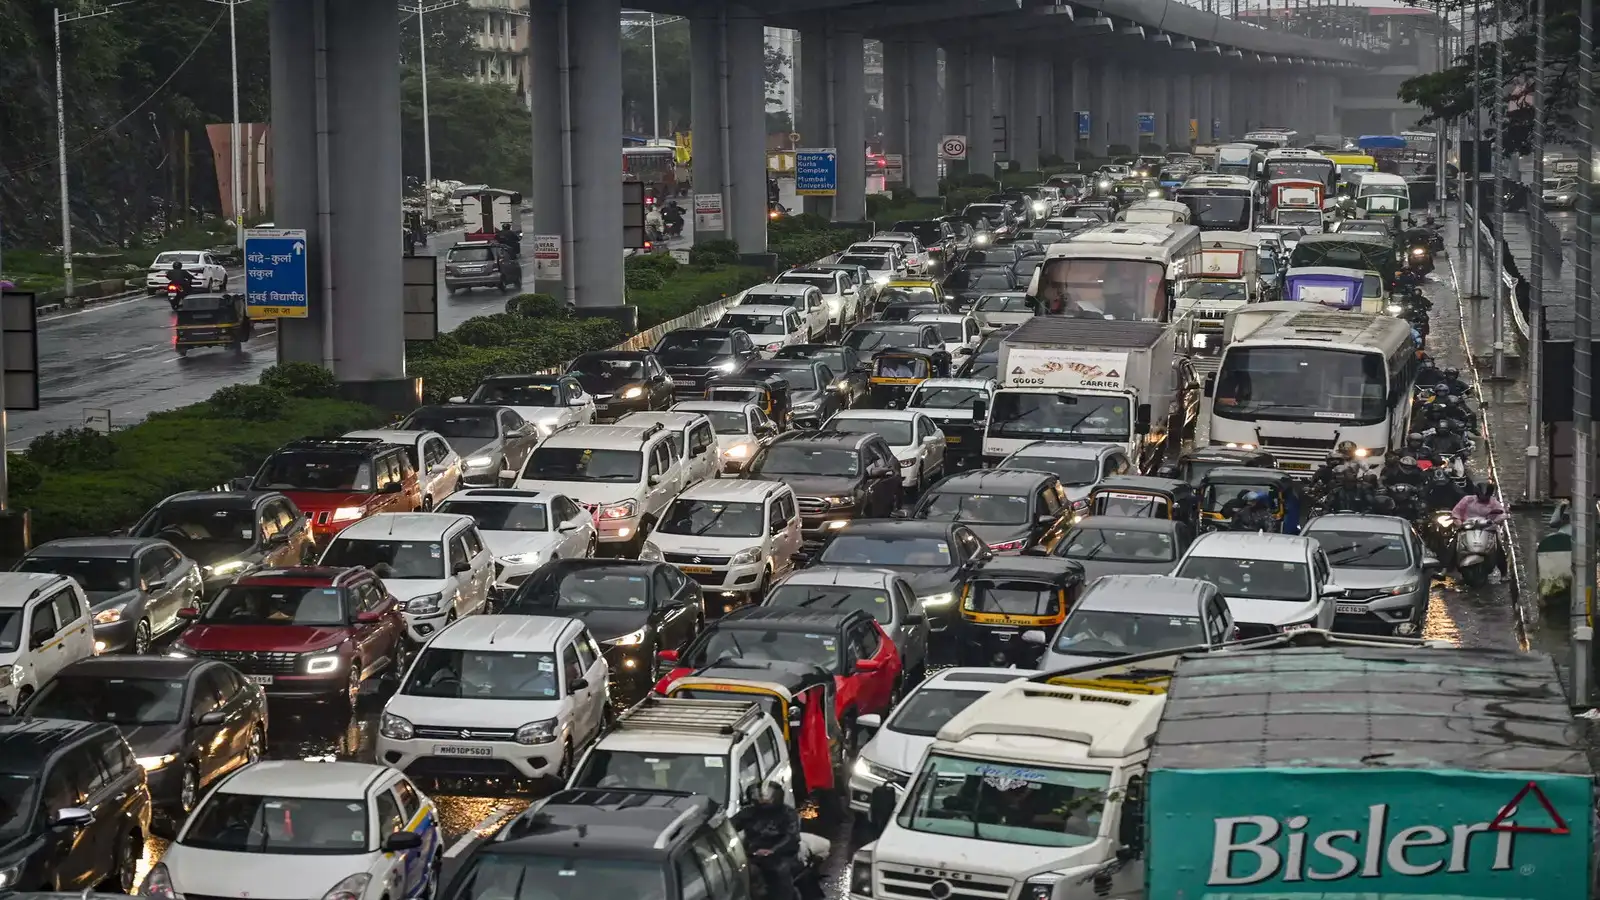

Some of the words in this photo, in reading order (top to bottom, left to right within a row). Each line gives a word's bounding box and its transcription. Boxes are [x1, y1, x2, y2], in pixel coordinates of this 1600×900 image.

[947, 143, 962, 151] 30
[249, 291, 267, 303] मुंबई
[1012, 377, 1045, 385] GOODS
[1080, 379, 1120, 388] CARRIER
[1206, 803, 1519, 887] Bisleri
[913, 867, 973, 881] FORCE
